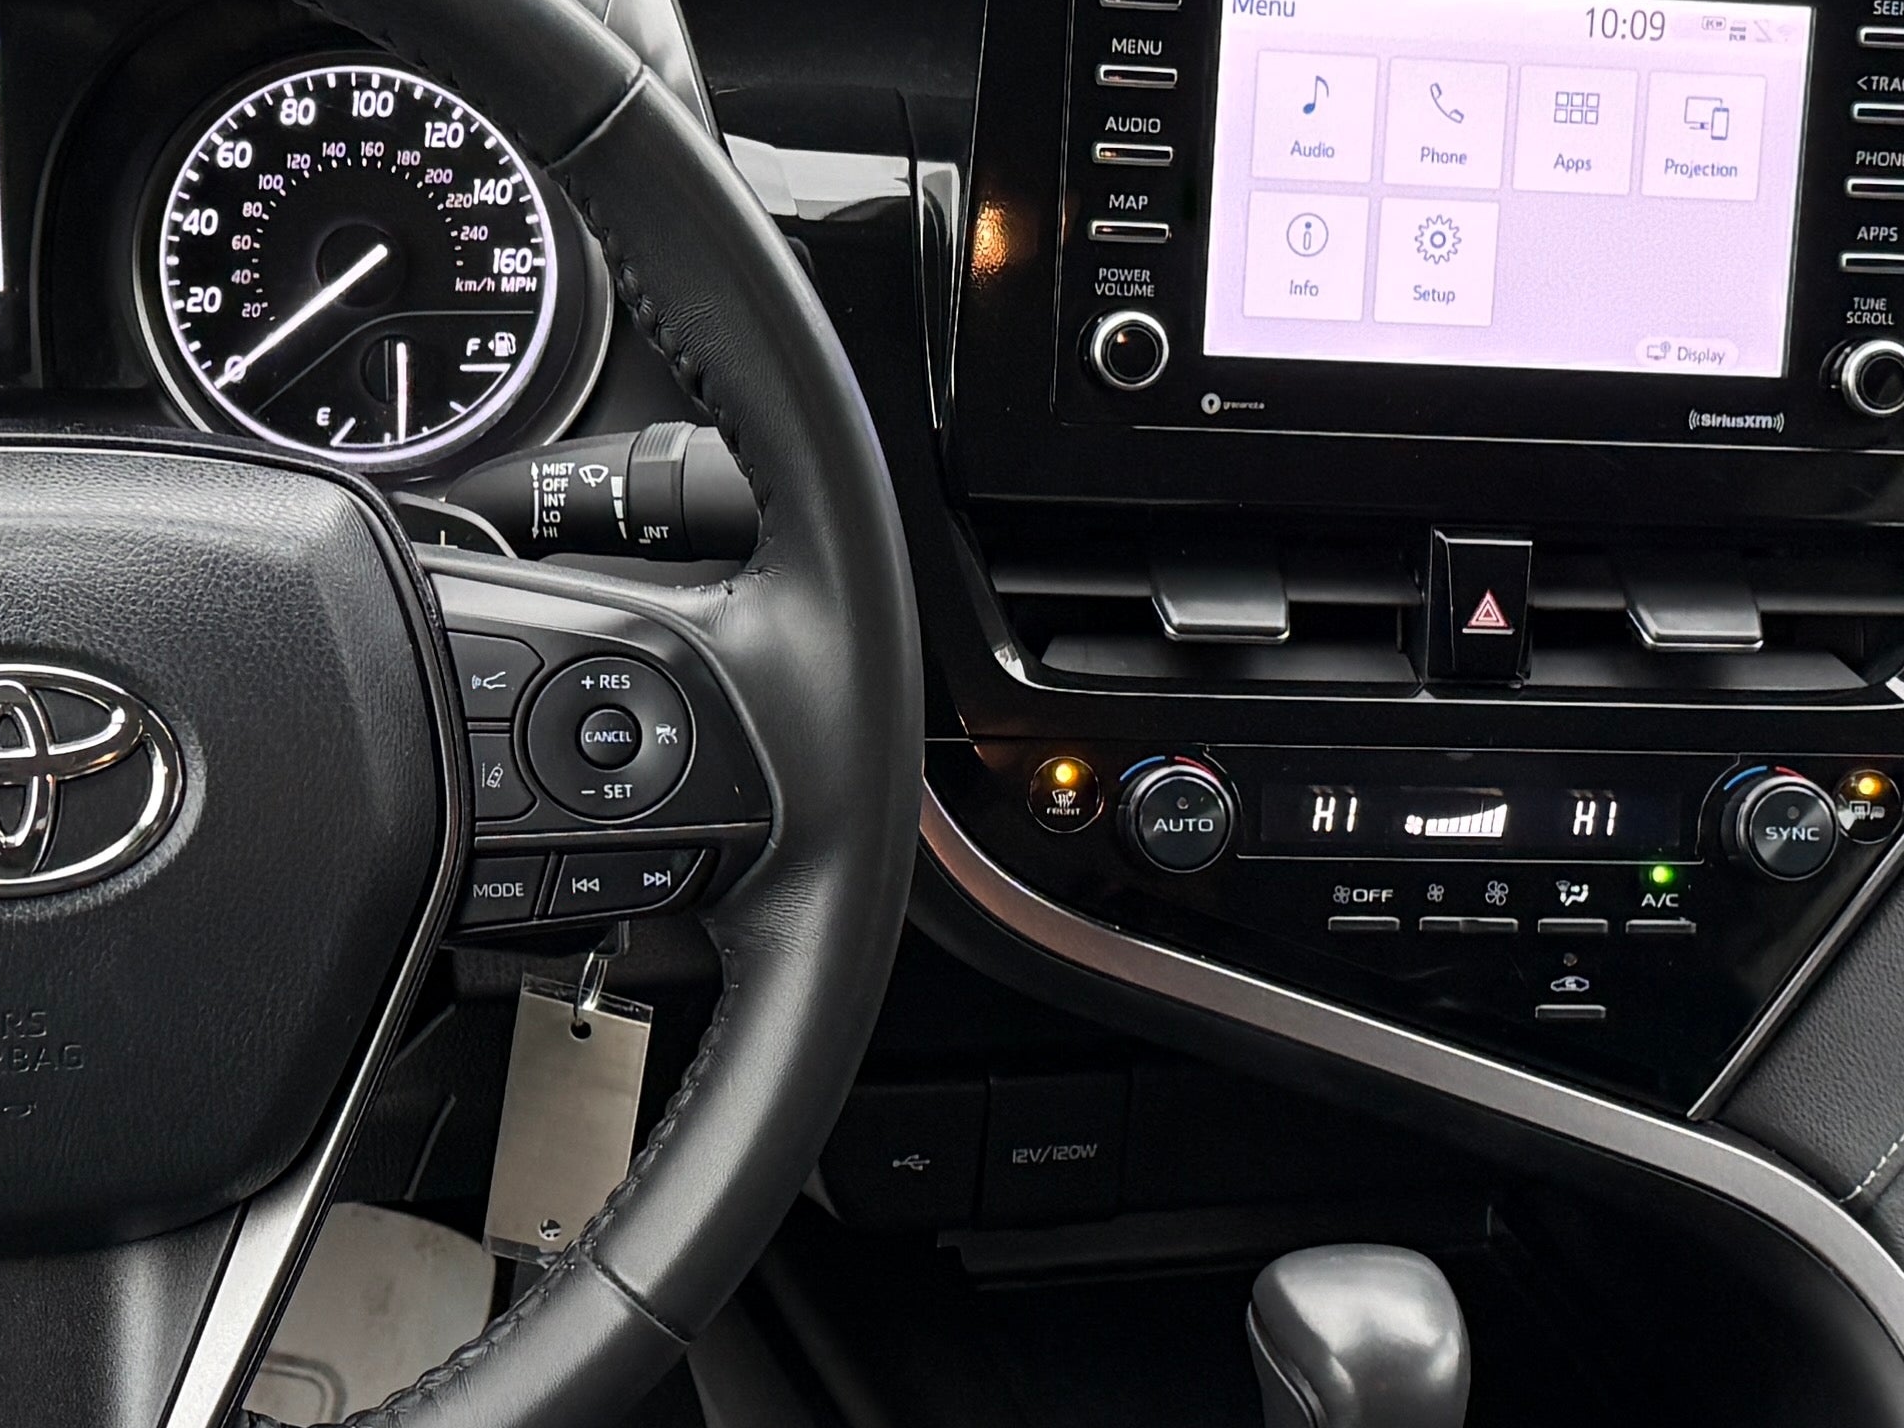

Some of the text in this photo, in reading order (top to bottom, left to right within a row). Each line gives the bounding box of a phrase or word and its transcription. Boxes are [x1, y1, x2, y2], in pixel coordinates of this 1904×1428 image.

[1585, 6, 1667, 42] 10:09
[1111, 37, 1163, 56] MENU
[279, 97, 316, 125] 80
[352, 90, 394, 118] 100
[1105, 116, 1162, 134] AUDIO
[424, 122, 465, 149] 120
[216, 141, 253, 169] 60
[322, 141, 346, 158] 140
[360, 141, 385, 157] 160
[1289, 139, 1336, 159] Audio
[1419, 146, 1468, 166] Phone
[286, 153, 311, 169] 120
[397, 150, 421, 166] 180
[1553, 153, 1593, 173] Apps
[424, 168, 453, 184] 200
[1663, 157, 1739, 179] Projection
[258, 174, 284, 190] 100
[473, 178, 513, 205] 140
[242, 201, 262, 218] 80
[445, 193, 473, 209] 220
[1109, 194, 1149, 211] MAP
[182, 208, 218, 236] 40
[460, 225, 489, 241] 240
[1856, 225, 1899, 242] APPS
[231, 234, 252, 251] 60
[492, 247, 533, 274] 160
[230, 269, 251, 285] 40
[1099, 267, 1152, 283] POWER
[455, 276, 538, 293] km/h MPH
[1095, 282, 1156, 298] VOLUME
[1288, 279, 1320, 298] Info
[186, 286, 222, 313] 20
[1412, 284, 1457, 305] Setup
[241, 302, 261, 318] 20
[1853, 297, 1887, 311] TUNE
[1846, 311, 1895, 326] SCROLL
[466, 338, 480, 357] F
[1676, 345, 1726, 366] Display
[316, 406, 332, 427] E
[542, 462, 576, 477] MIST
[542, 478, 569, 492] OFF
[543, 493, 567, 508] INT
[543, 509, 561, 523] LO
[543, 525, 558, 539] HI
[644, 525, 670, 540] INT
[598, 674, 631, 690] RES
[585, 730, 633, 744] CANCEL
[603, 784, 634, 799] SET
[1311, 796, 1359, 833] HI
[1572, 800, 1618, 836] HI
[1153, 818, 1215, 833] AUTO
[1765, 826, 1820, 842] SYNC
[472, 883, 525, 899] MODE
[1352, 888, 1394, 903] OFF
[1641, 892, 1679, 908] A/C
[1012, 1144, 1098, 1164] 12V/120W
